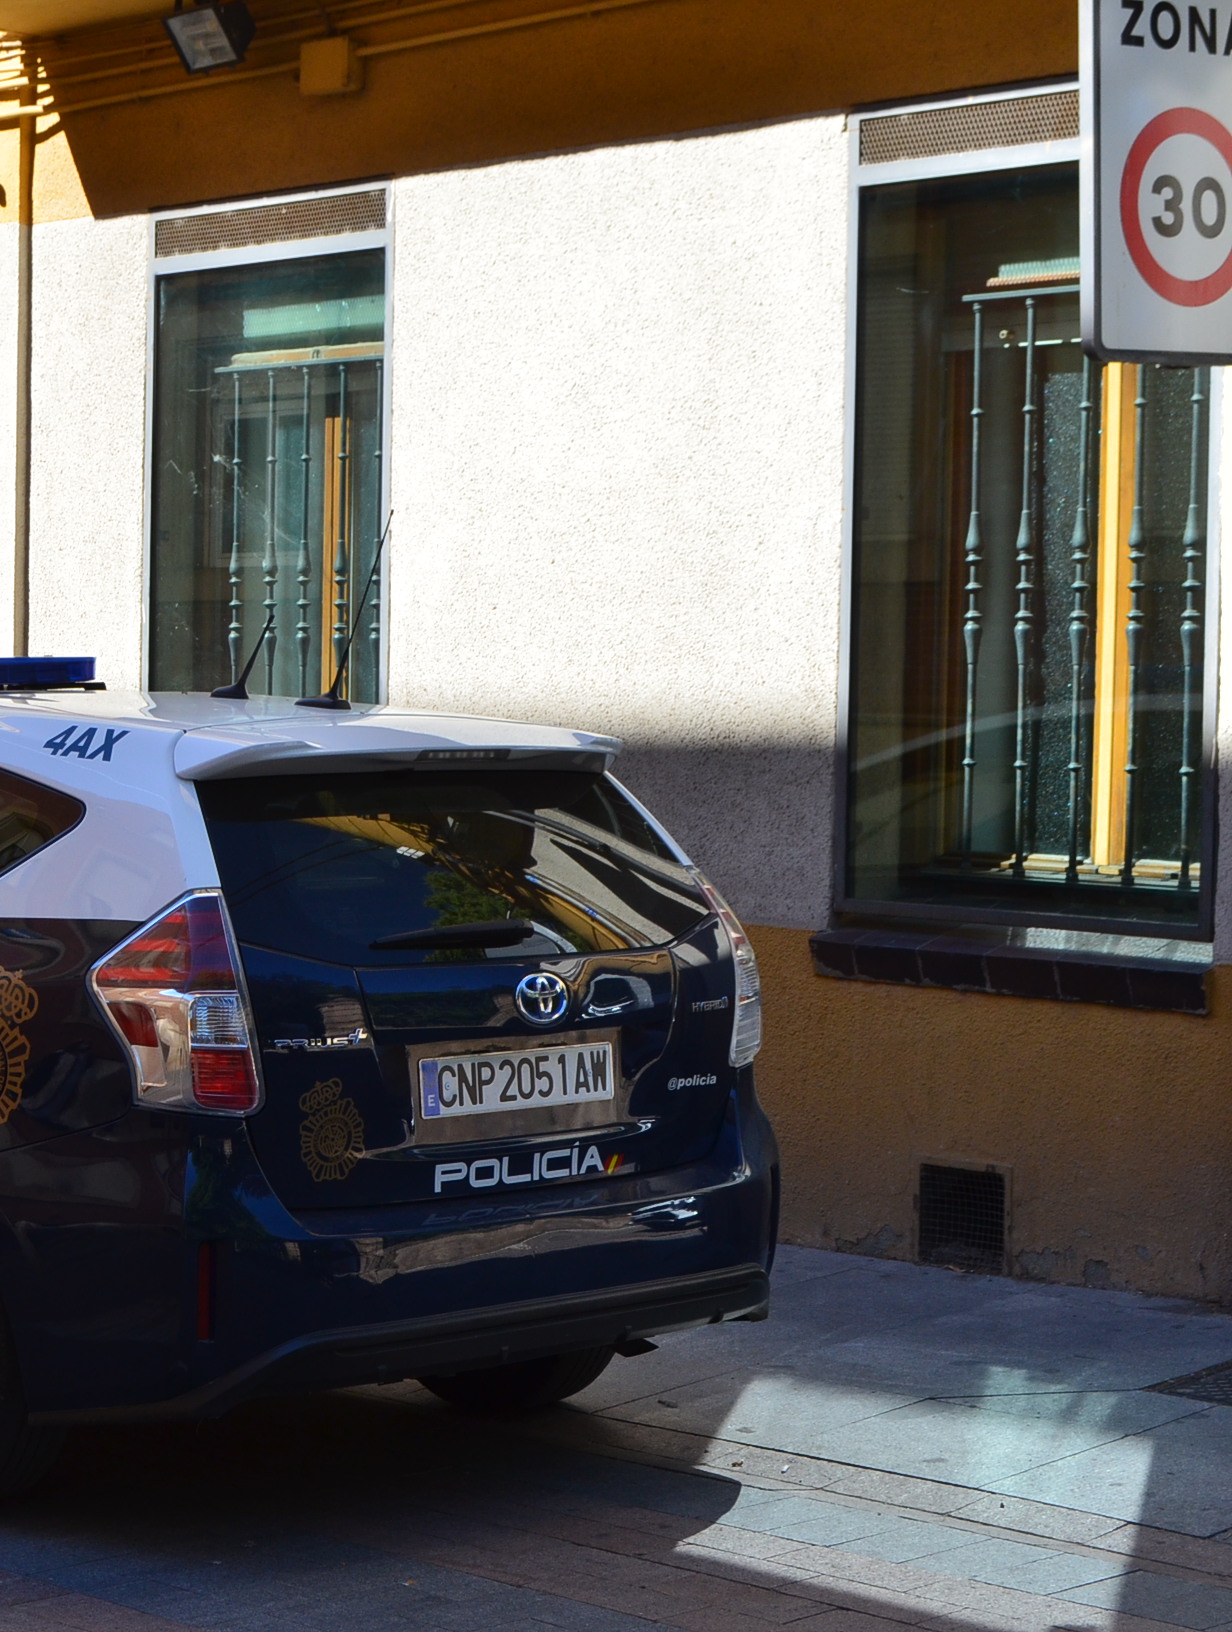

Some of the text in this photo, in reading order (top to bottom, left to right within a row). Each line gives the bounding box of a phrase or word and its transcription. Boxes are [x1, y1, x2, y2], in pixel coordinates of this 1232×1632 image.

[1120, 0, 1232, 56] ZON
[1151, 174, 1226, 239] 30
[42, 725, 131, 762] 4AX
[427, 1094, 436, 1107] E
[667, 1073, 717, 1091] @policia
[434, 1141, 604, 1193] POLICÍA
